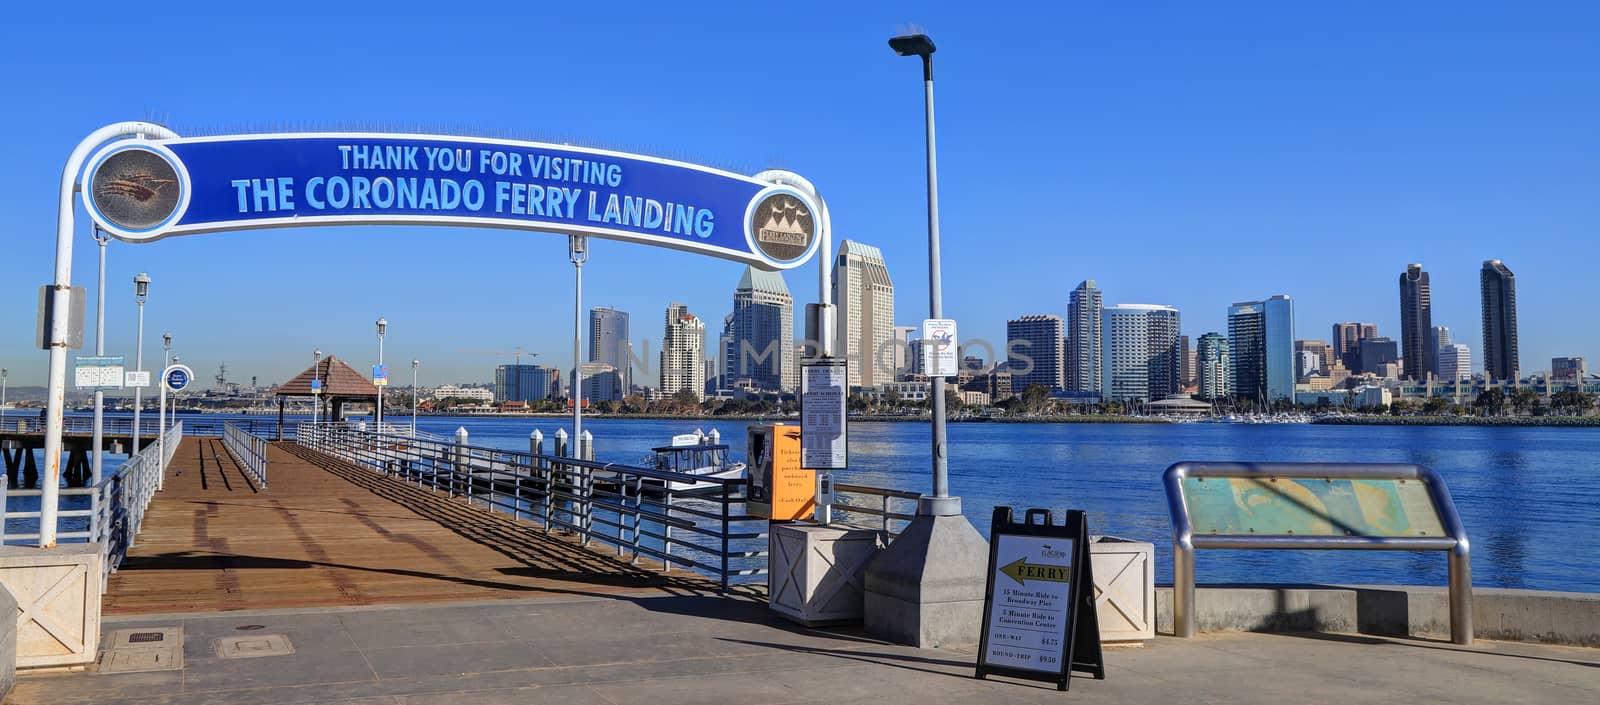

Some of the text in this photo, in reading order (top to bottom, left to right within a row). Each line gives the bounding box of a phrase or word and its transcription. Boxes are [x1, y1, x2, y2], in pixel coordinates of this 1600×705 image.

[338, 144, 622, 188] THANK YOU FOR VISITING
[231, 175, 715, 239] THE CORONADO FERRY LANDING
[1017, 566, 1067, 579] FERRY
[1003, 588, 1059, 600] 15 Minute Ride to
[1007, 596, 1053, 607] Broadway Pier
[1008, 609, 1031, 618] Minute
[1031, 612, 1046, 620] Ride
[998, 616, 1034, 626] Convention
[992, 650, 1032, 661] ROUND-TRIP
